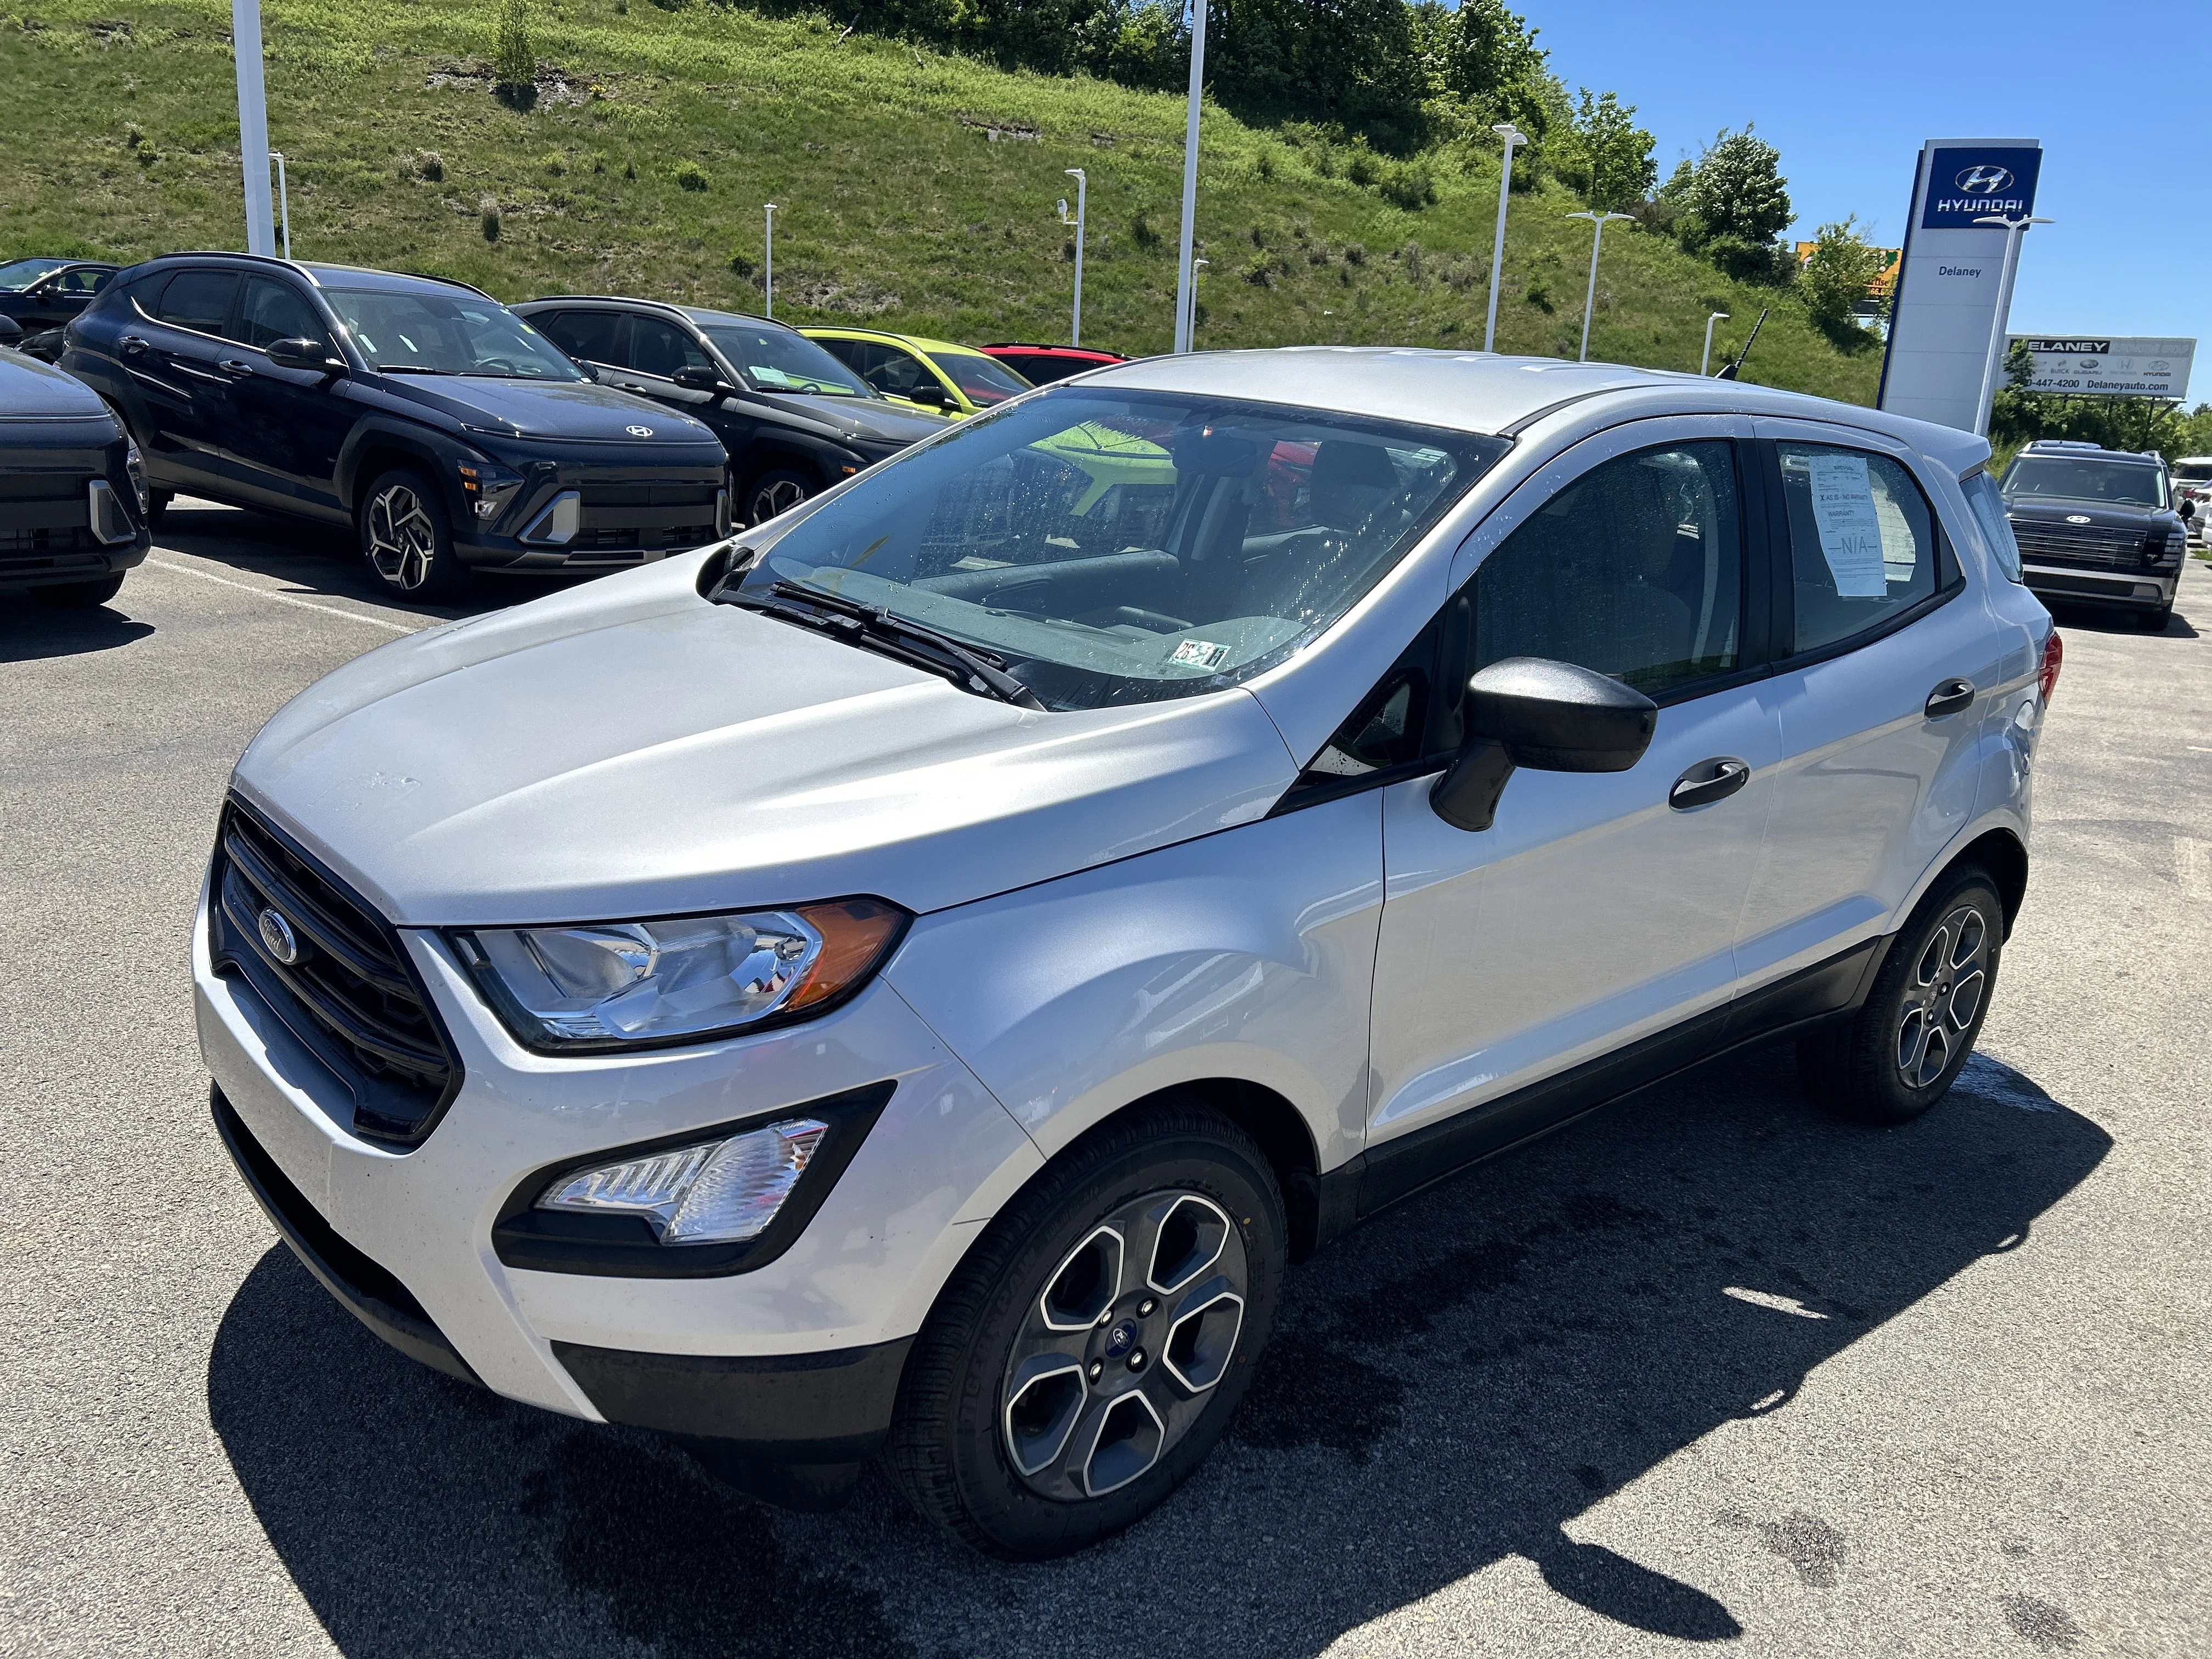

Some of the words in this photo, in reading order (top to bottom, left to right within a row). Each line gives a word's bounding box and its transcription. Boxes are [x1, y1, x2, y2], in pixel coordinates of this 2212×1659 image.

[1937, 199, 2023, 212] HYUNDAI
[1939, 266, 1982, 278] Delaney
[2028, 341, 2108, 352] ELANEY
[2028, 379, 2080, 388] 0-447-4200
[2087, 380, 2169, 391] Delaneyauto.com
[263, 918, 281, 951] Ford
